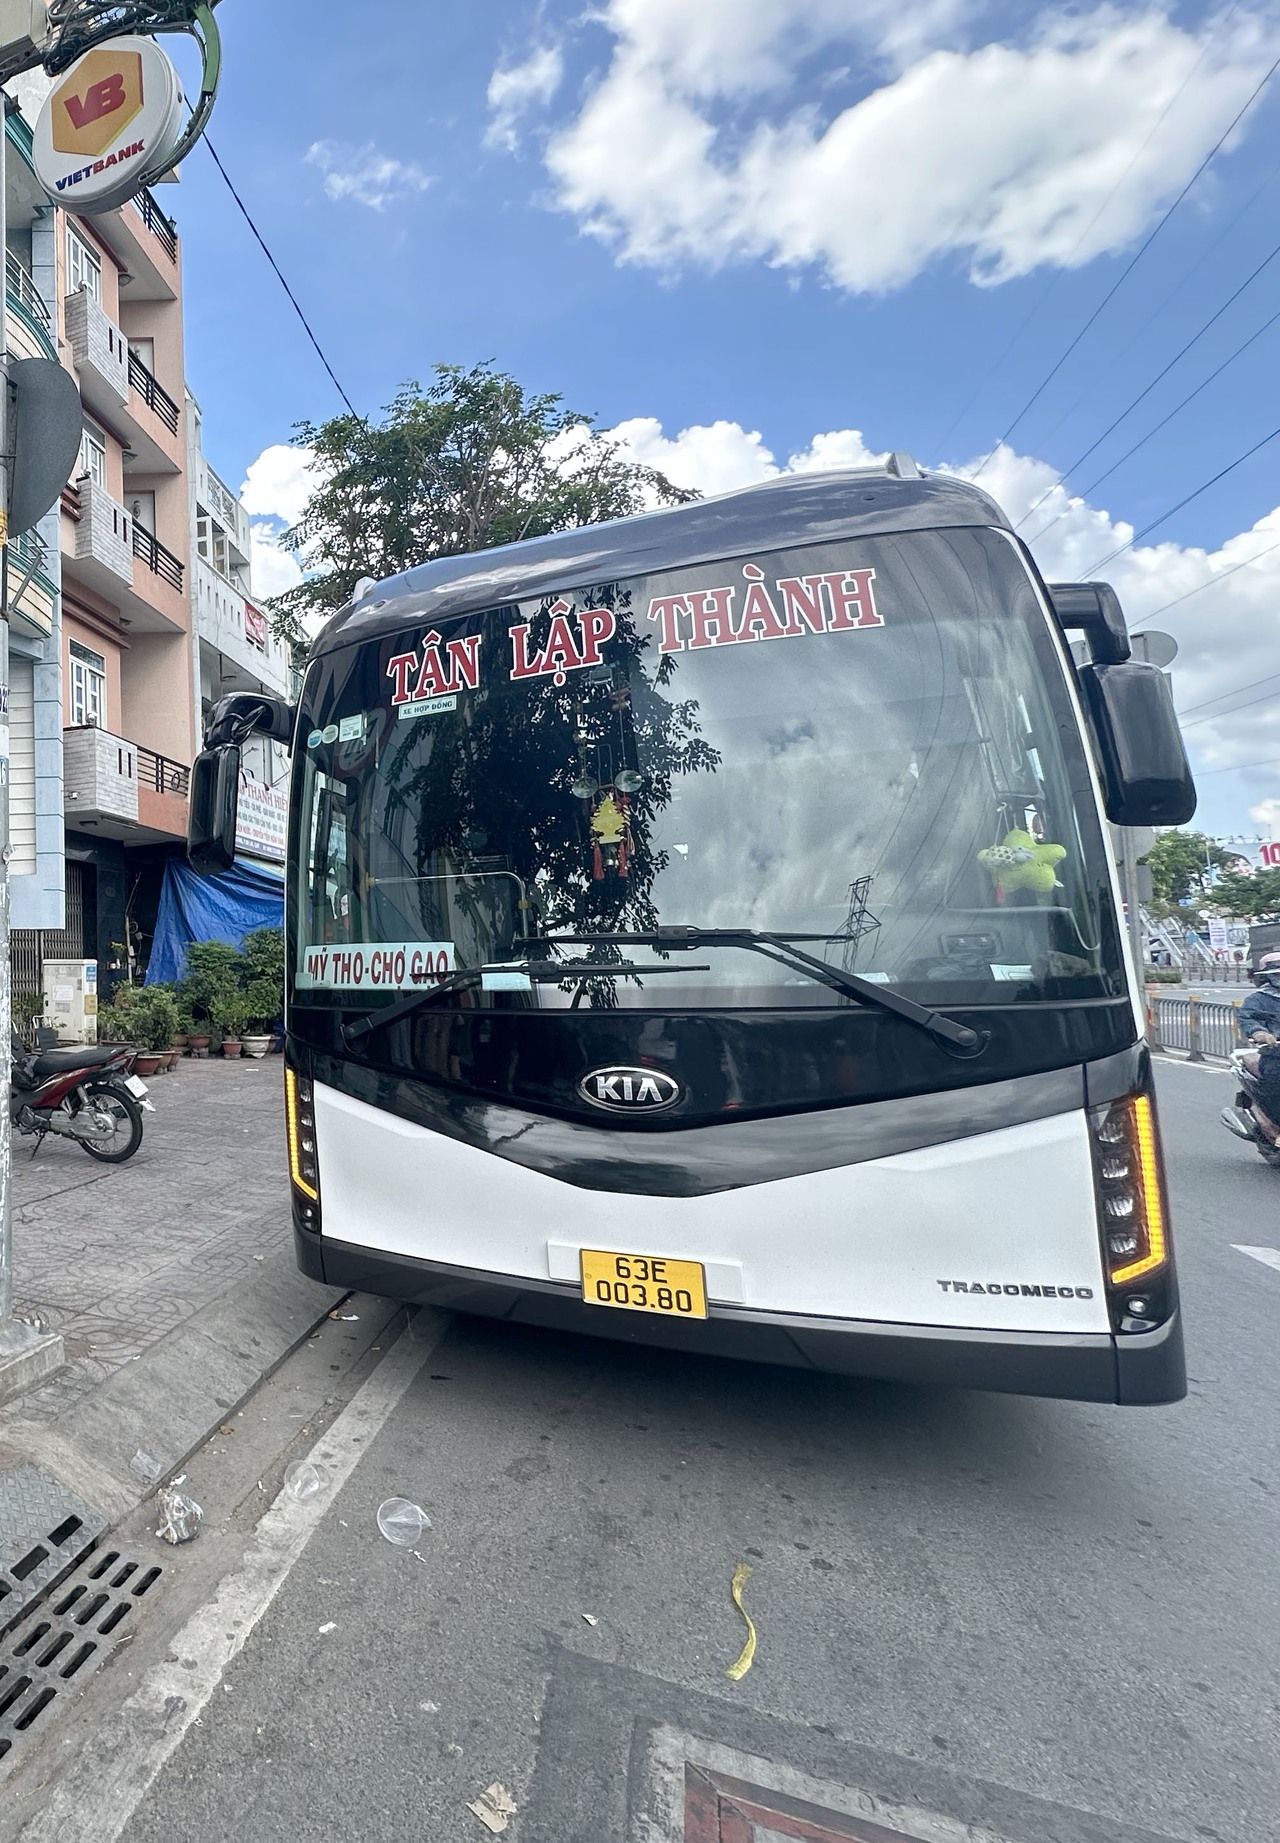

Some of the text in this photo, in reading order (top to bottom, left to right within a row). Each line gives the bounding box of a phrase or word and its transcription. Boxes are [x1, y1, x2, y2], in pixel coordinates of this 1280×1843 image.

[55, 139, 145, 191] VIETBANK
[386, 563, 885, 706] TÂN LẬP THÀNH
[595, 1075, 663, 1102] KIA
[616, 1256, 668, 1284] 63E
[596, 1280, 692, 1313] 003.80
[936, 1279, 1094, 1300] TRACOMECO
